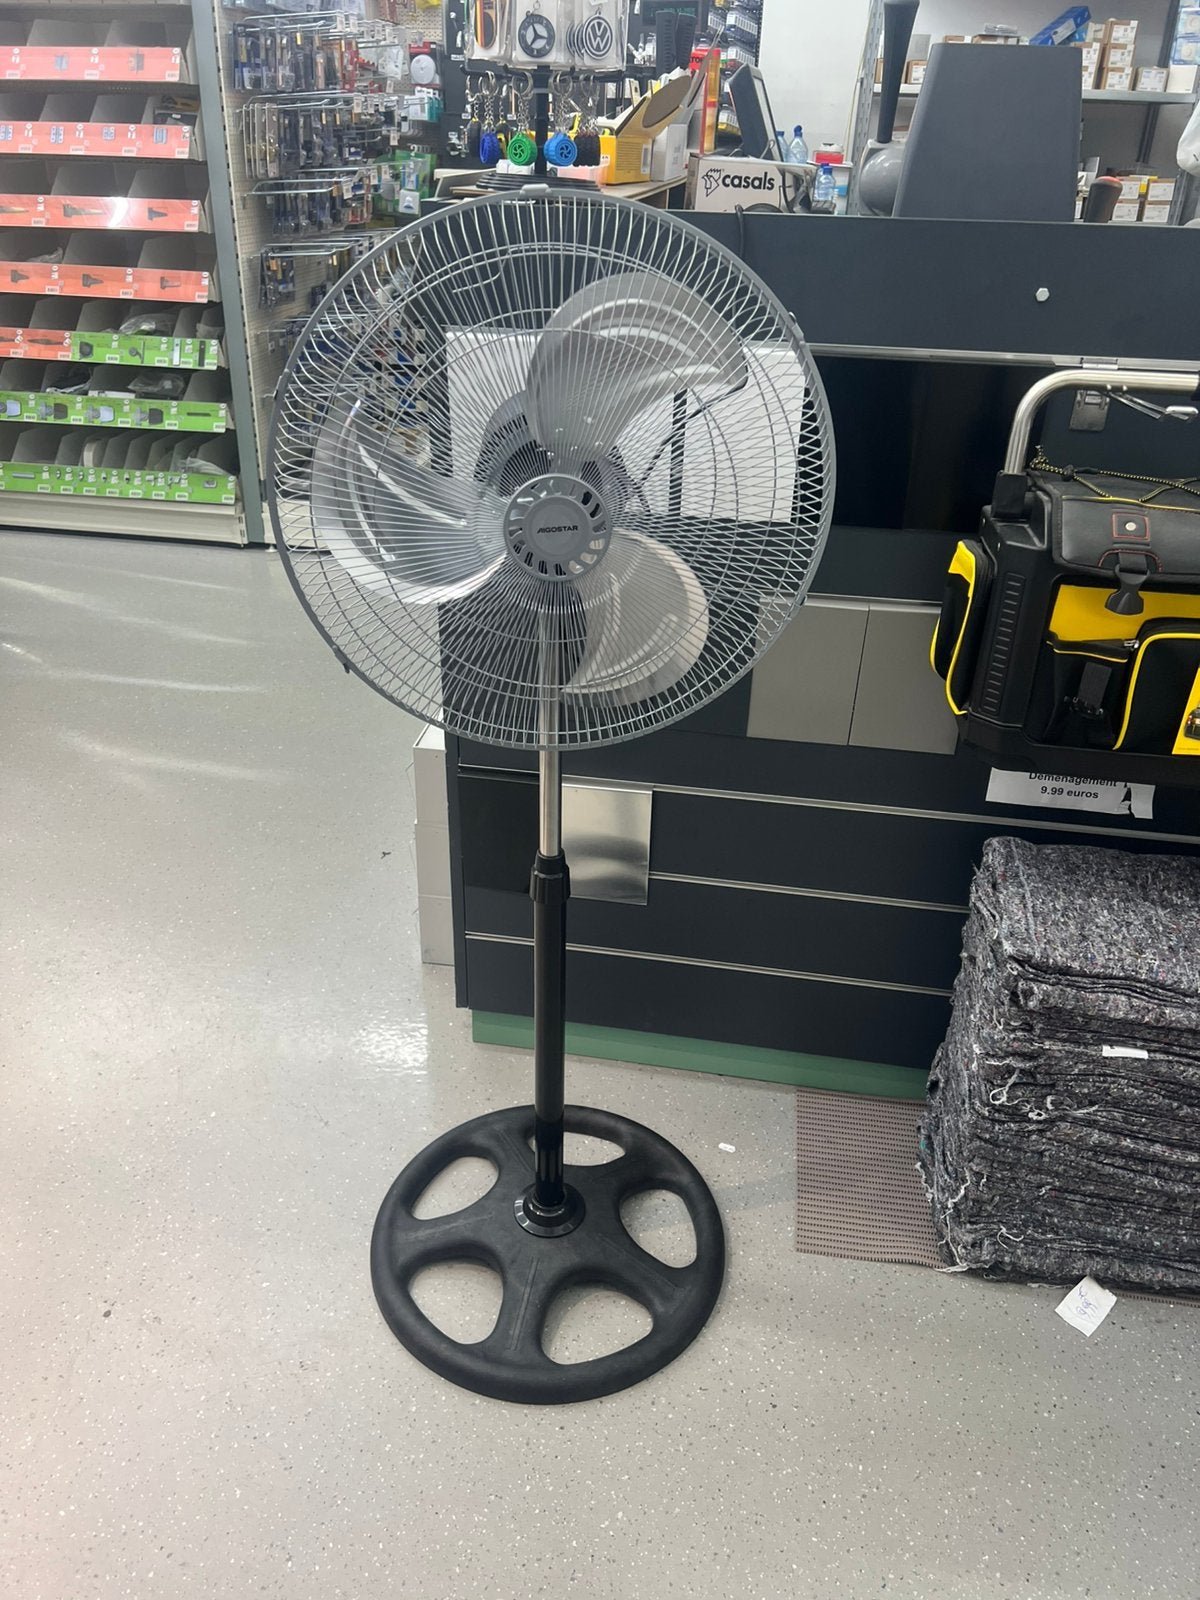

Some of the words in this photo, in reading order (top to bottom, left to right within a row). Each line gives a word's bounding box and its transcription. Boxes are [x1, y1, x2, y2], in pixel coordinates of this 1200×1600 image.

[722, 171, 775, 191] casals
[537, 525, 578, 534] AIGOSTAR
[1041, 786, 1064, 796] 9.99
[1066, 789, 1099, 799] euros
